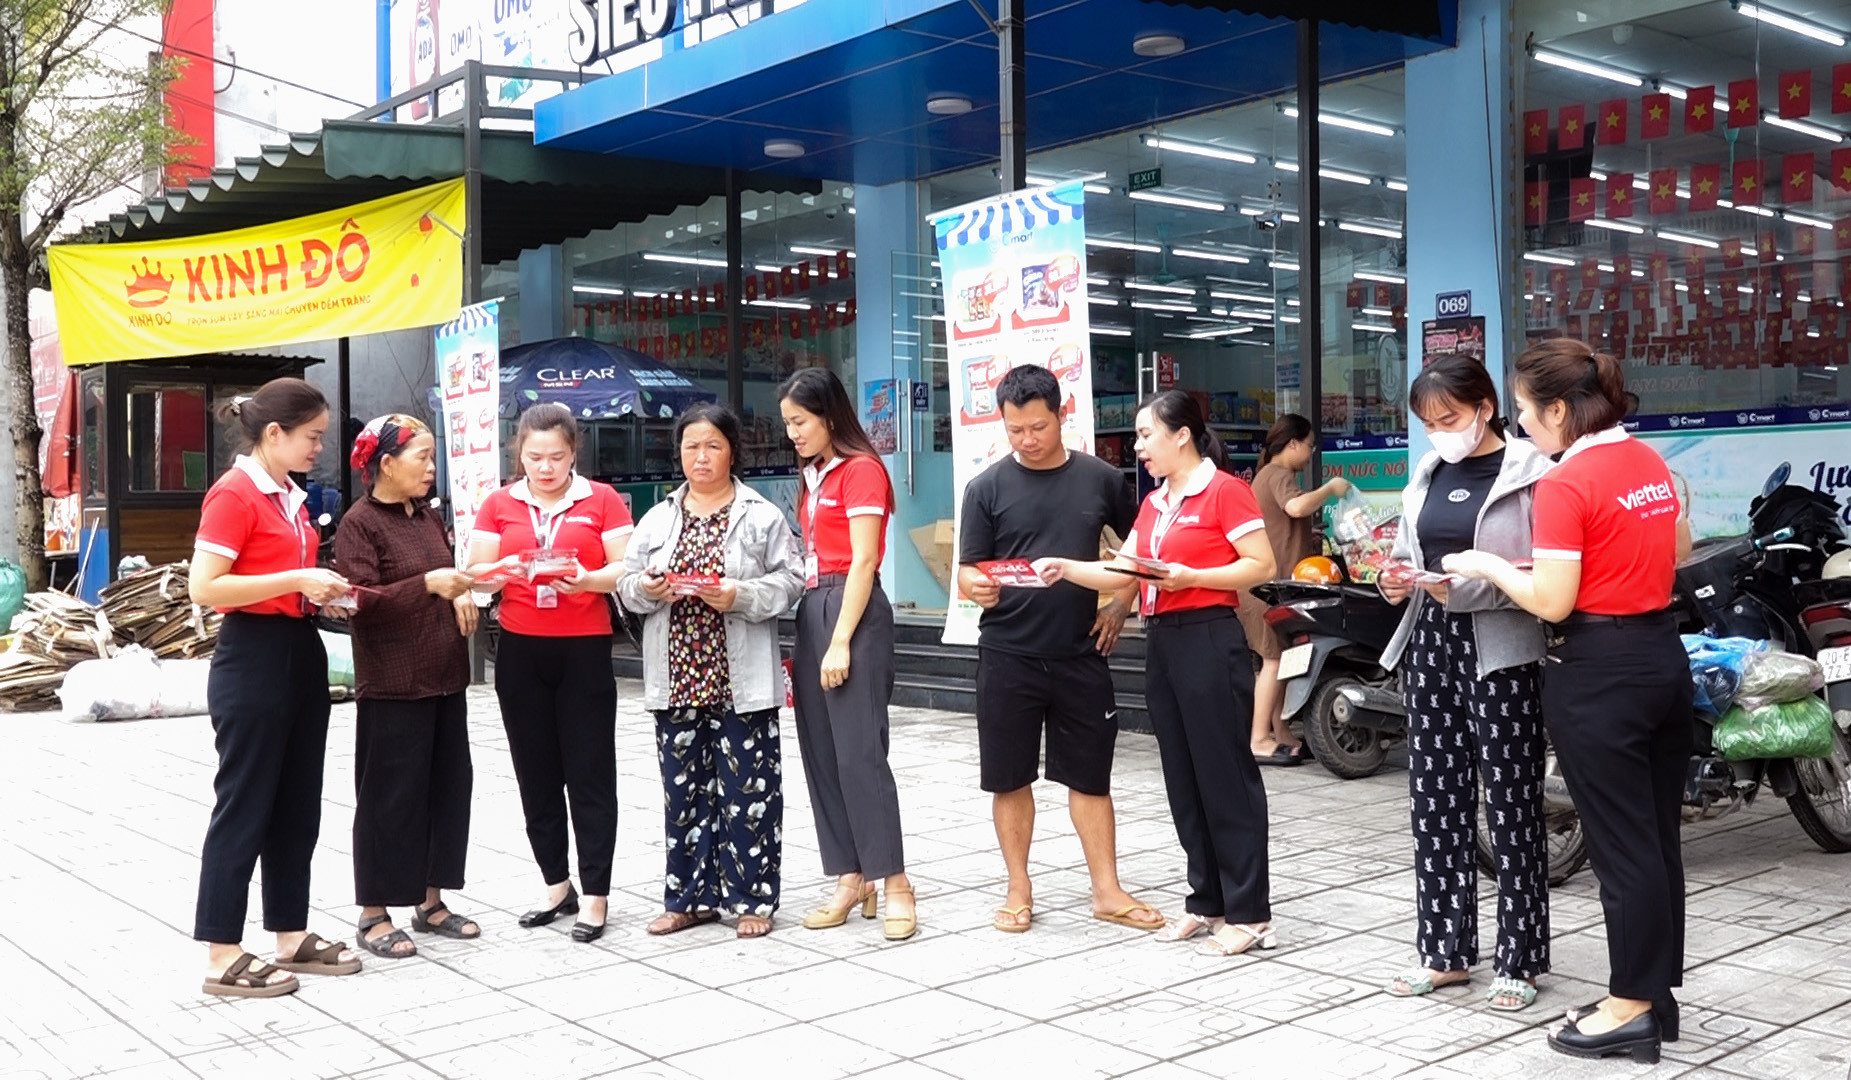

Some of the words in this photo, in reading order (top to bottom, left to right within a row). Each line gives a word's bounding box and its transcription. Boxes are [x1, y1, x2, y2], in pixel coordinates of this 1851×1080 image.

[494, 0, 532, 24] OM
[450, 26, 472, 57] OMO
[1134, 171, 1157, 185] EXIT
[183, 244, 288, 304] KINH
[300, 217, 370, 289] ĐÔ
[1439, 296, 1468, 314] 069
[536, 367, 615, 382] CLEAR
[1616, 480, 1673, 511] viettel
